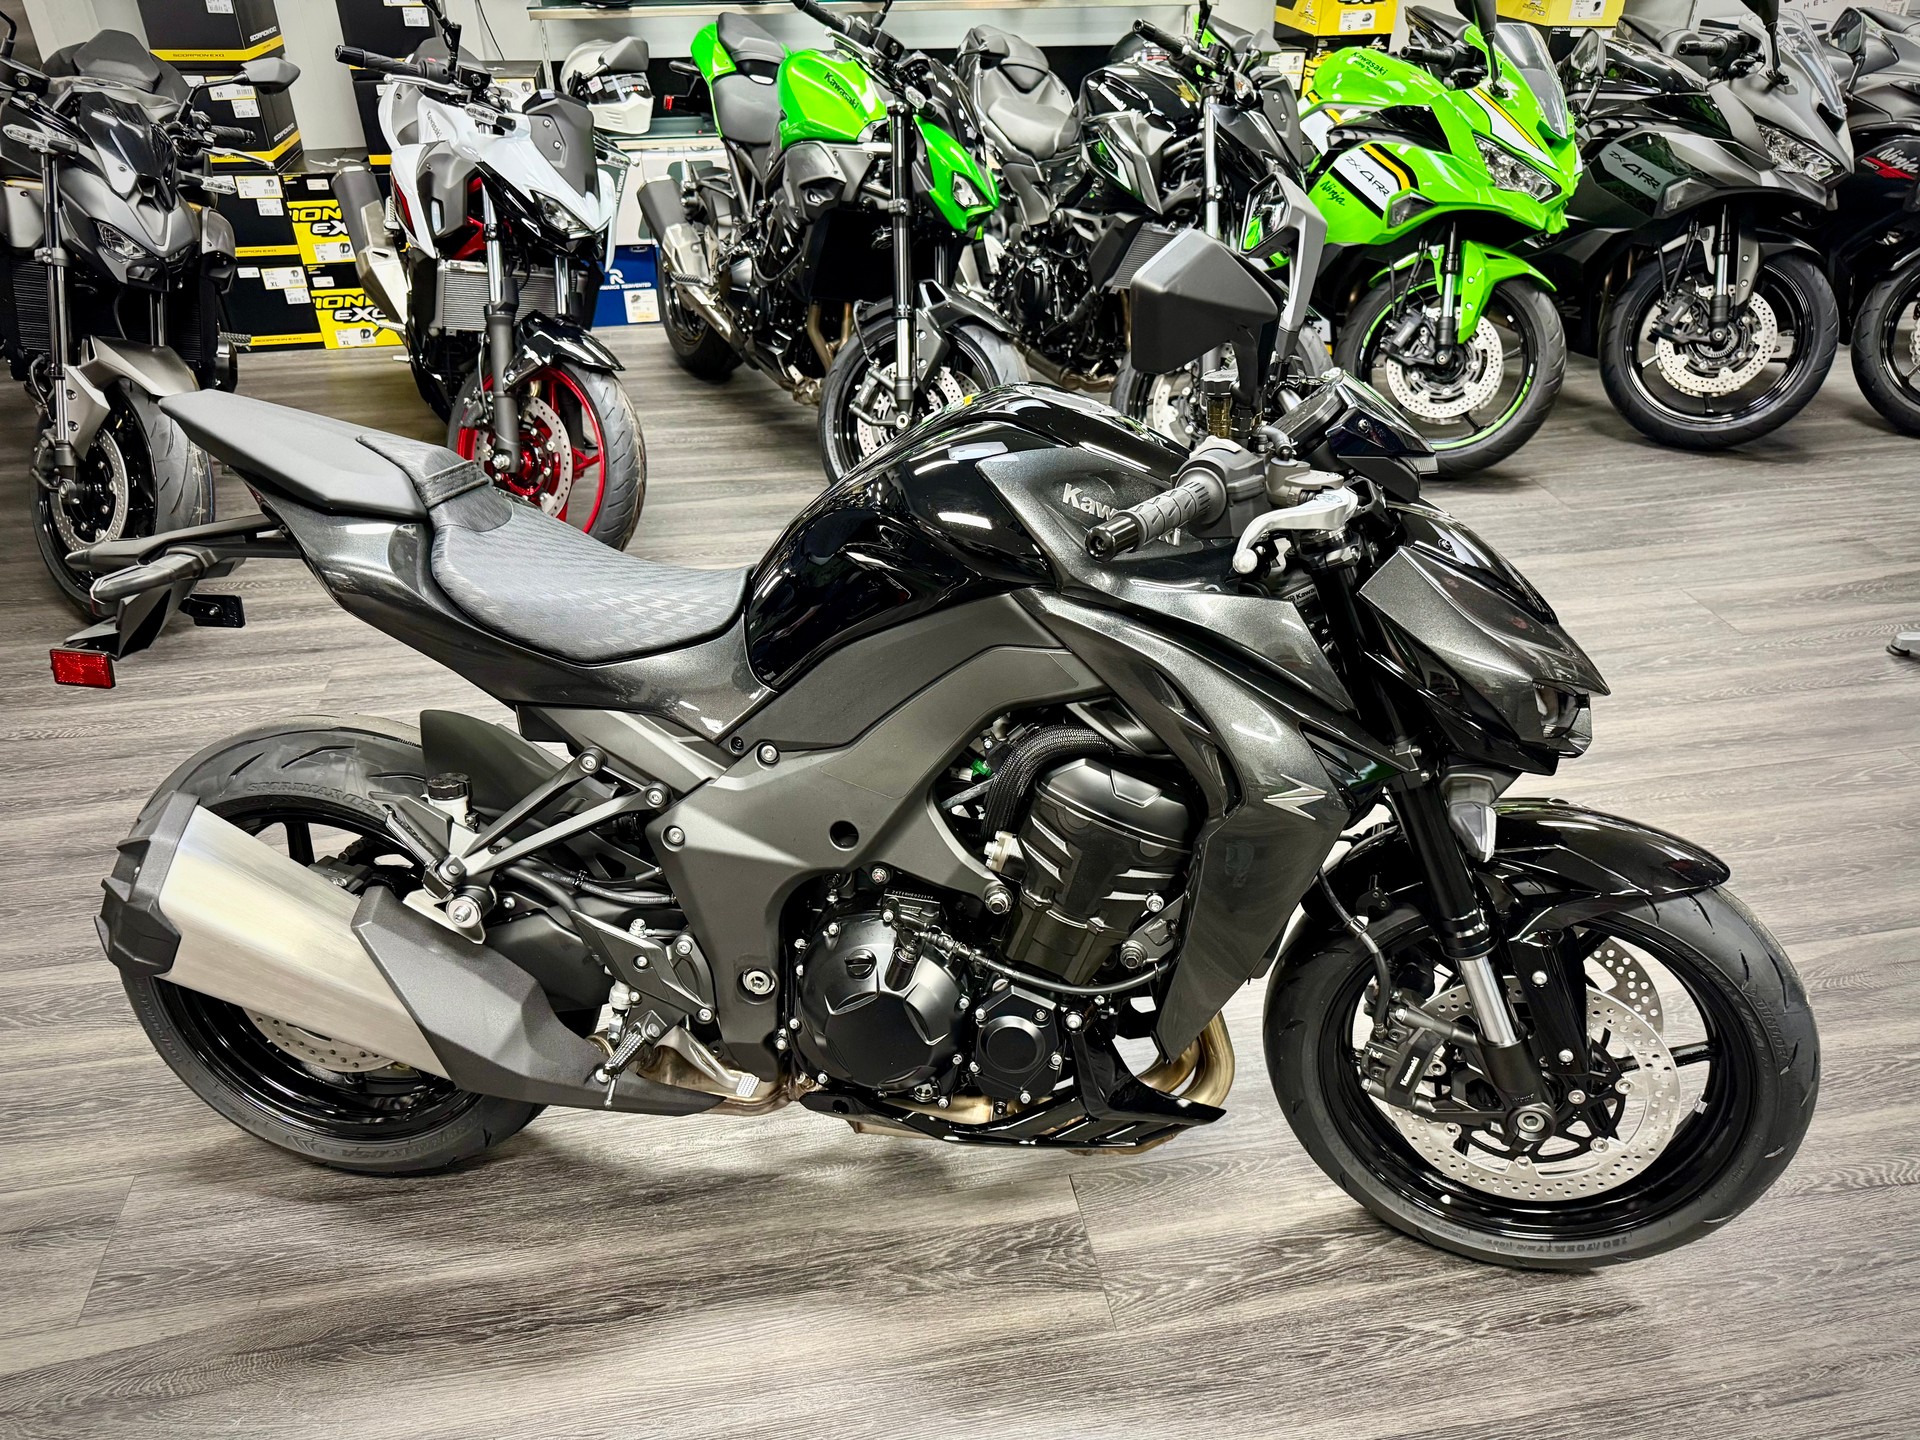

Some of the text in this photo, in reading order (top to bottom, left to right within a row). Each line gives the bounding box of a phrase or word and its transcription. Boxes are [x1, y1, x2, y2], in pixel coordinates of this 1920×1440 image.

[216, 91, 224, 99] M
[824, 71, 860, 110] Kawasaki
[1876, 147, 1919, 174] Ninja
[616, 169, 626, 193] WORLD
[1320, 180, 1346, 207] Ninja
[289, 207, 342, 222] ION
[311, 220, 349, 236] EX
[312, 295, 365, 309] ION
[1399, 1056, 1420, 1087] Kawasaki
